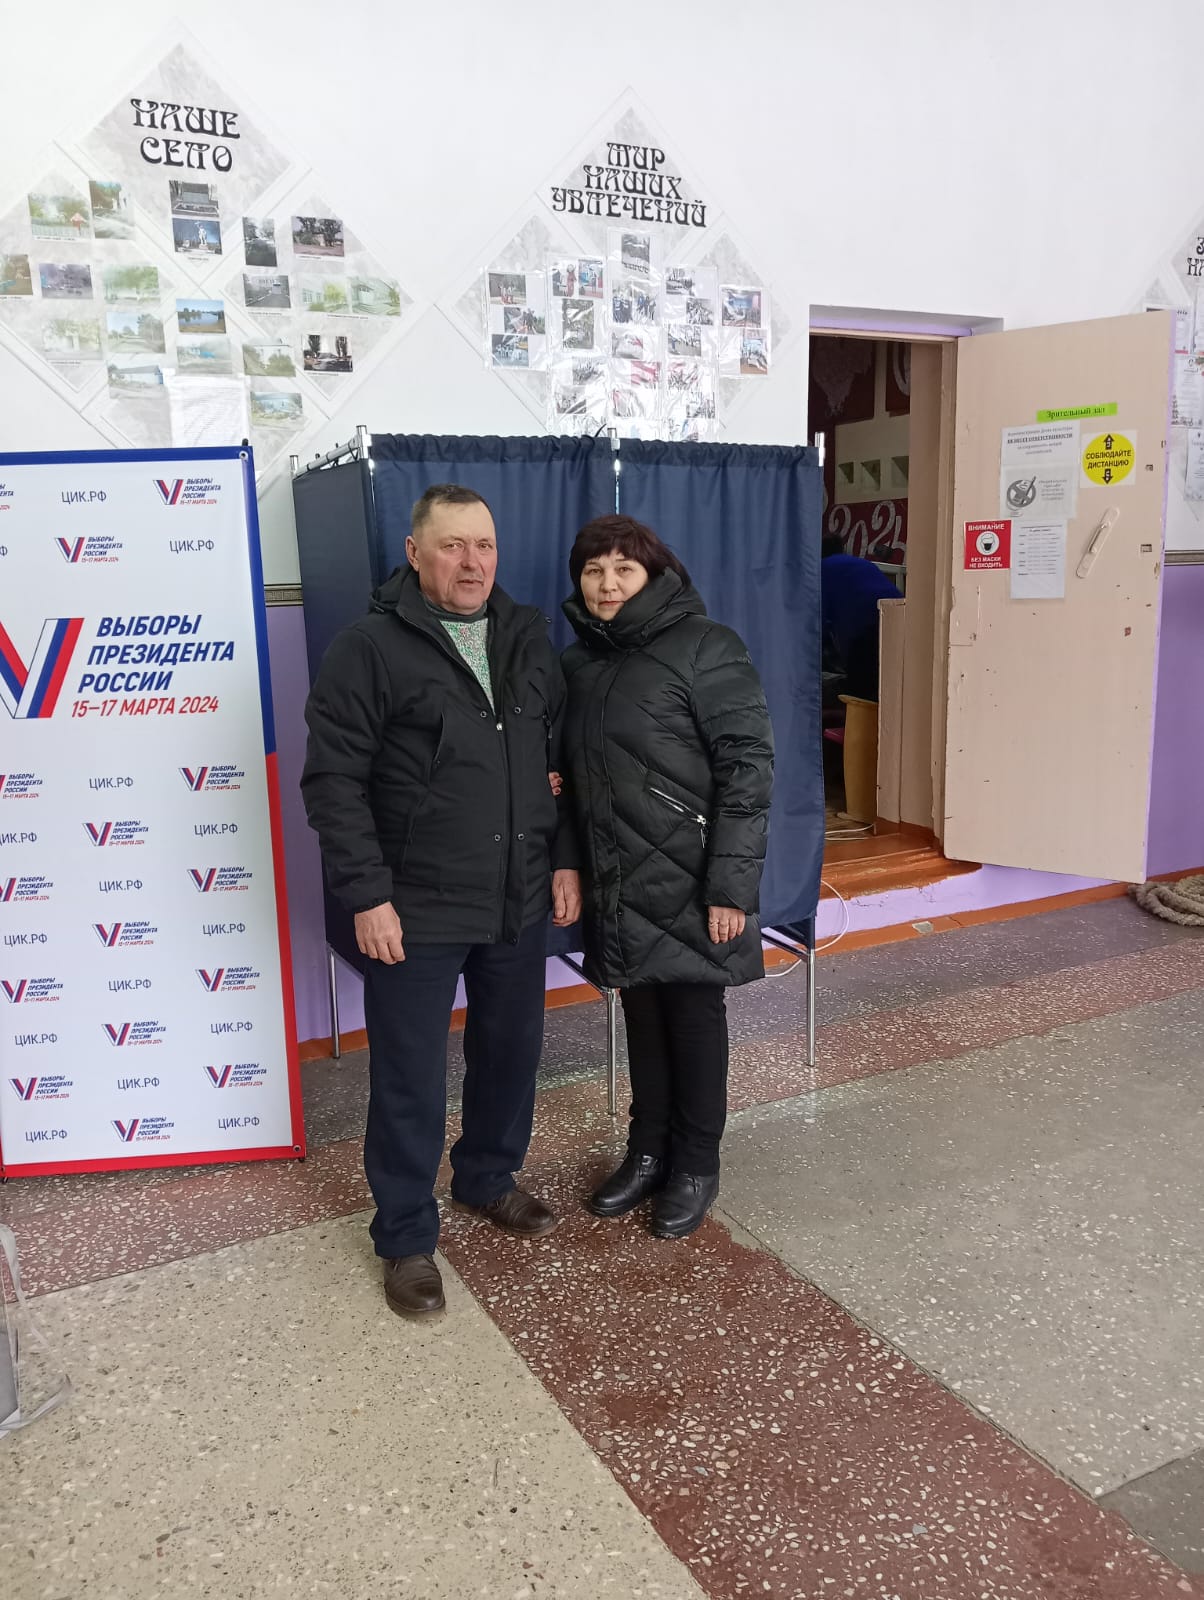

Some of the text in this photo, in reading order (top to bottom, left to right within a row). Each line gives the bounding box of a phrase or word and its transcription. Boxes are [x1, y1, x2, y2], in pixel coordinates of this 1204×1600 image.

[130, 98, 240, 139] НАШЕ
[140, 137, 232, 172] СЕЛО
[606, 142, 665, 171] МИР
[583, 165, 682, 200] НАШИХ
[551, 187, 706, 228] УВЛЕЧЕНИЙ
[1086, 450, 1132, 459] СОБЛЮДАЙТЕ
[1088, 460, 1129, 469] ДИСТАНЦИЮ
[62, 490, 107, 504] ЦИК.РФ
[170, 540, 214, 554] ЦИК.РФ
[96, 614, 202, 637] ВЫБОРЫ
[87, 641, 235, 666] ПРЕЗИДЕНТА
[78, 671, 173, 693] РОССИИ
[119, 698, 175, 716] МАРТА
[178, 696, 219, 714] 2024
[89, 777, 134, 790] ЦИК.РФ
[194, 823, 238, 837] ЦИК.РФ
[99, 879, 143, 893] ЦИК.РФ
[202, 922, 246, 936] ЦИК.РФ
[4, 934, 48, 947] ЦИК.РФ
[108, 979, 152, 992] ЦИК.РФ
[210, 1021, 253, 1035] ЦИК.РФ
[15, 1033, 58, 1047] ЦИК.РФ
[117, 1077, 160, 1091] ЦИК.РФ
[218, 1117, 260, 1130] ЦИК.РФ
[25, 1129, 68, 1143] ЦИК.РФ
